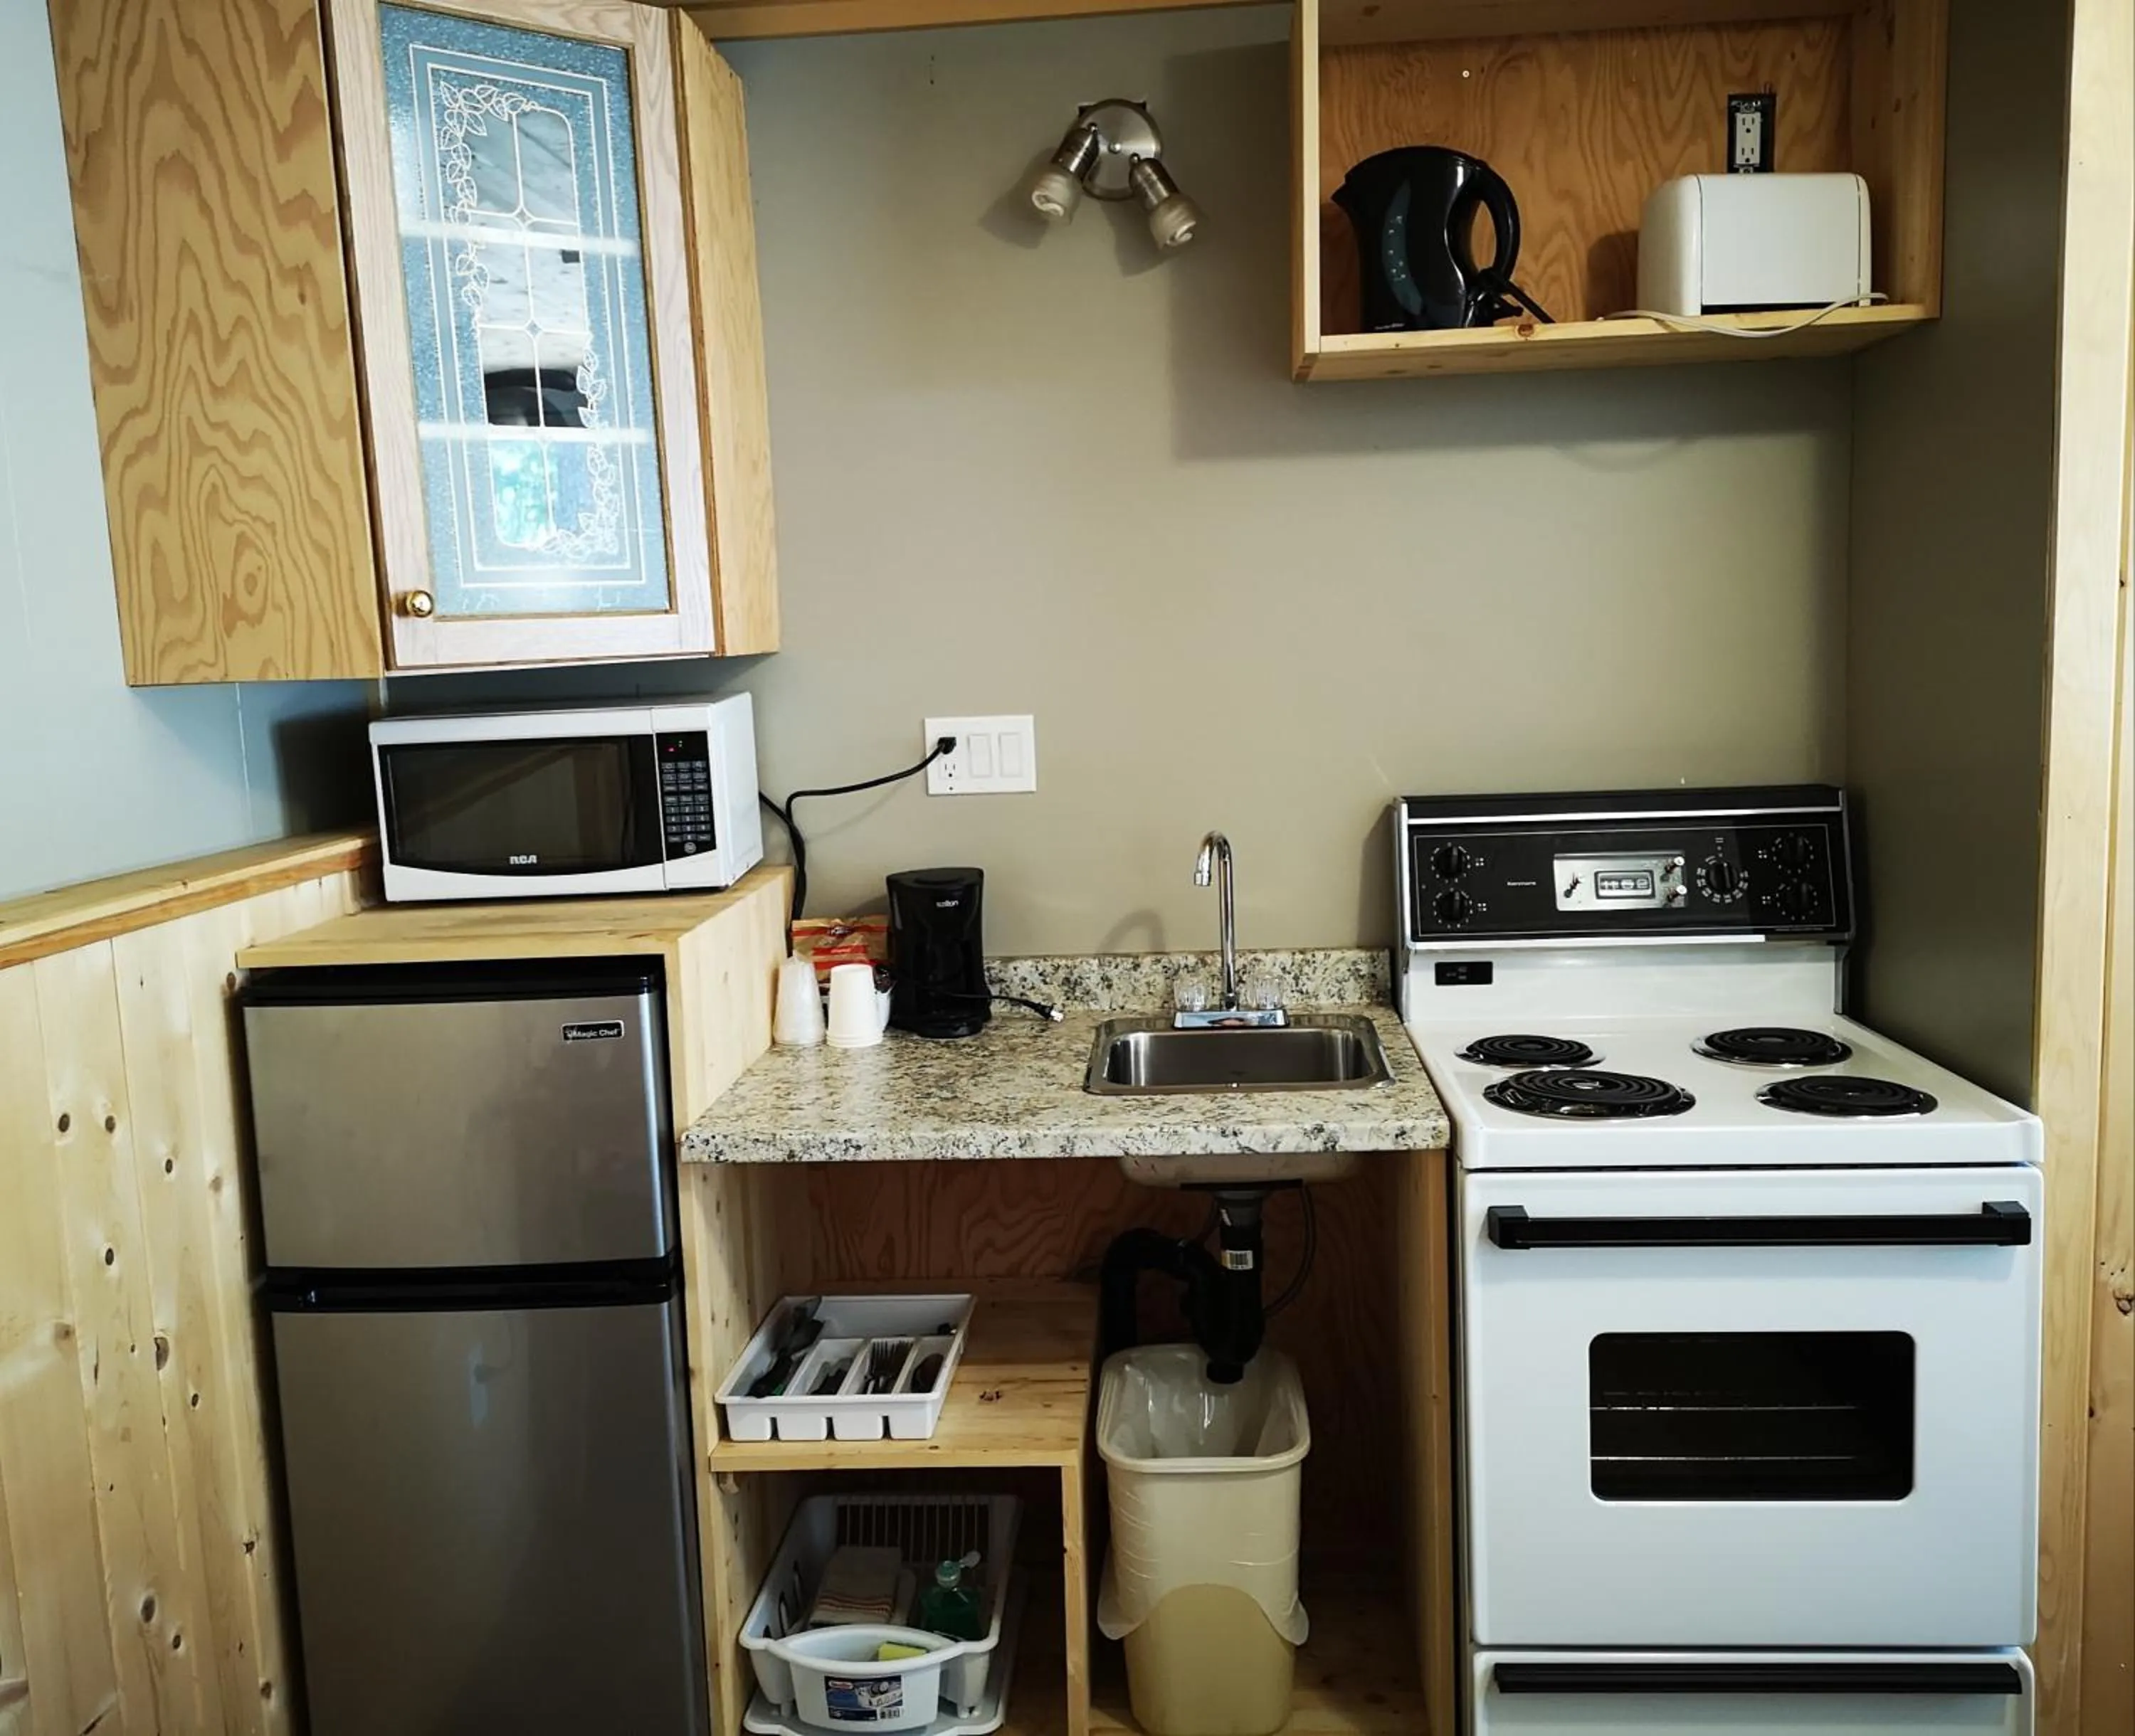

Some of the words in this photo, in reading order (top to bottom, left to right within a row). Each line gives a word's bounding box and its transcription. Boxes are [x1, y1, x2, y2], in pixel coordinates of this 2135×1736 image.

[509, 854, 538, 865] RCA
[572, 1030, 599, 1038] Magic
[599, 1028, 618, 1037] Chef
